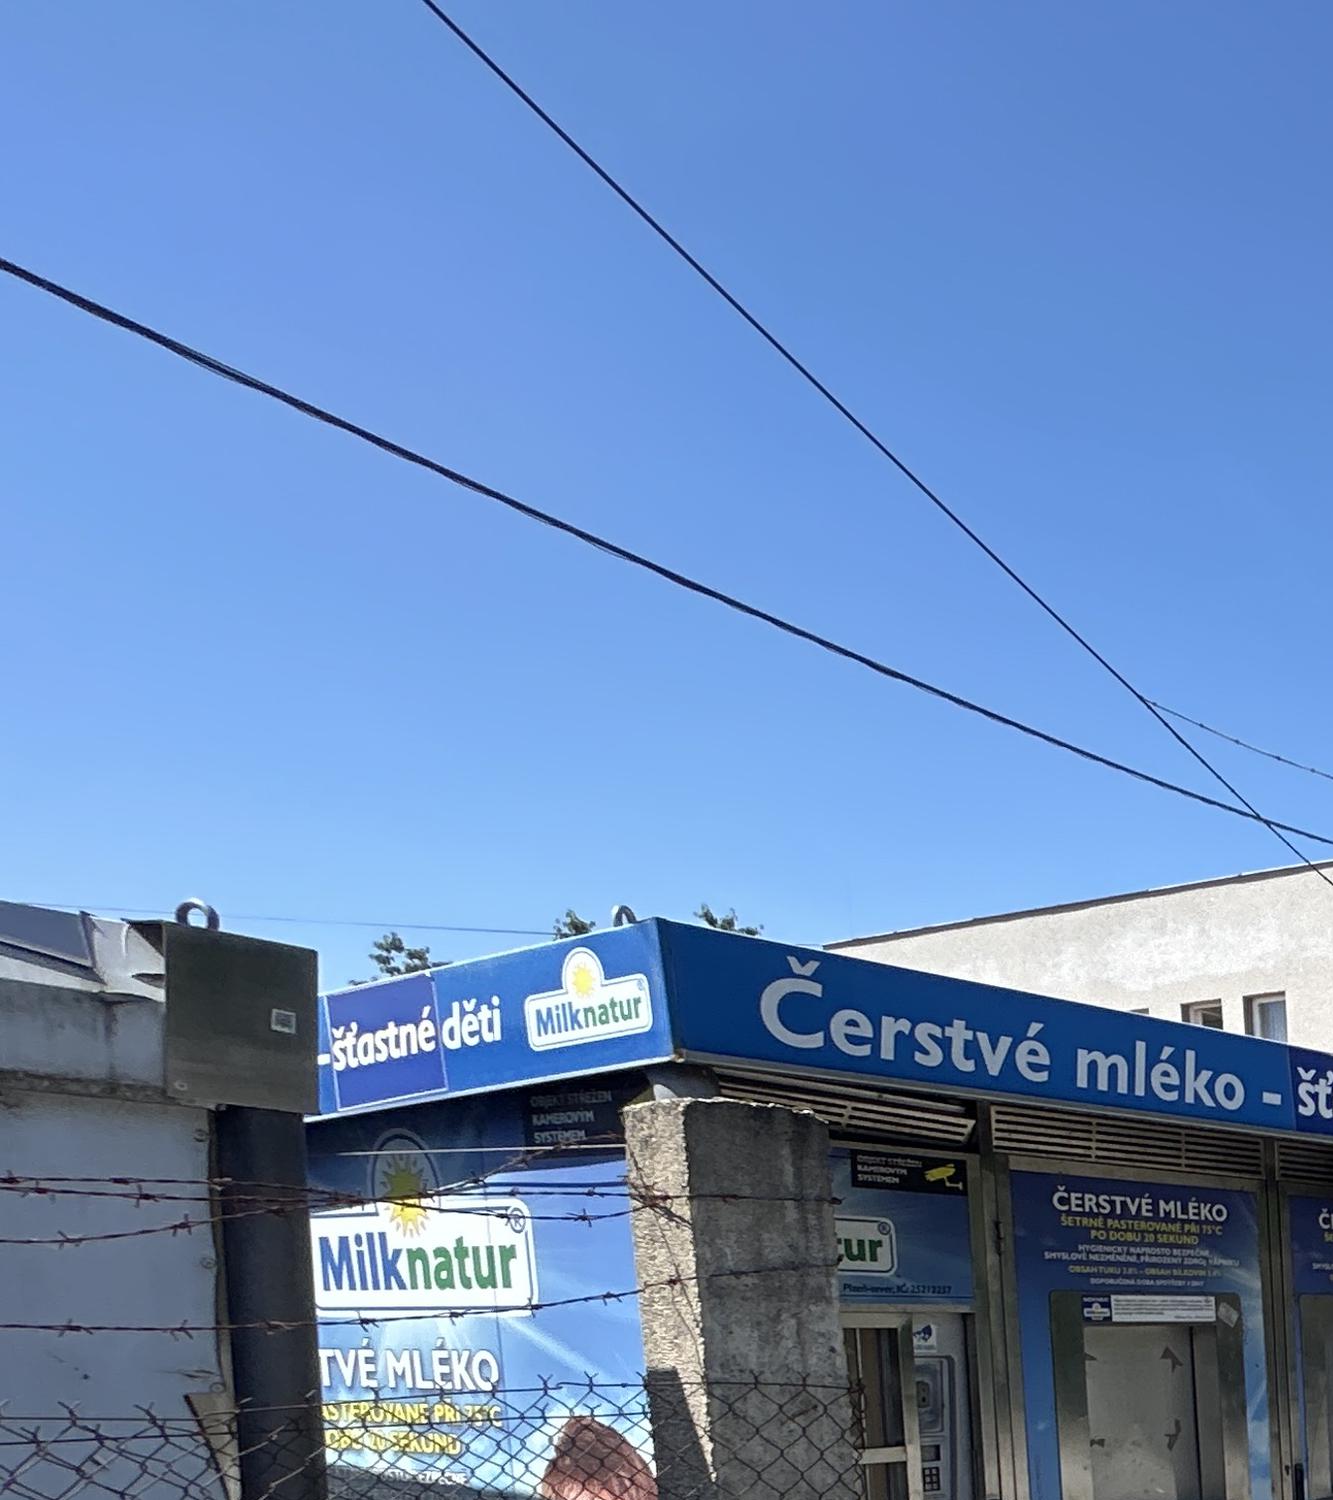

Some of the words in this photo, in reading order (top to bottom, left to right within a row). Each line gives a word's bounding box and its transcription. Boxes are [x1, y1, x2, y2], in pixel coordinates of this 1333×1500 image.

[442, 996, 502, 1050] děti
[535, 996, 643, 1038] Milknatur
[760, 955, 1051, 1082] Čerstvé
[1076, 1045, 1246, 1111] mléko
[1052, 1185, 1154, 1218] ČERSTVÉ
[1159, 1197, 1228, 1222] MLÉKO
[319, 1231, 517, 1291] Milknatur
[386, 1337, 499, 1391] MLÉKO
